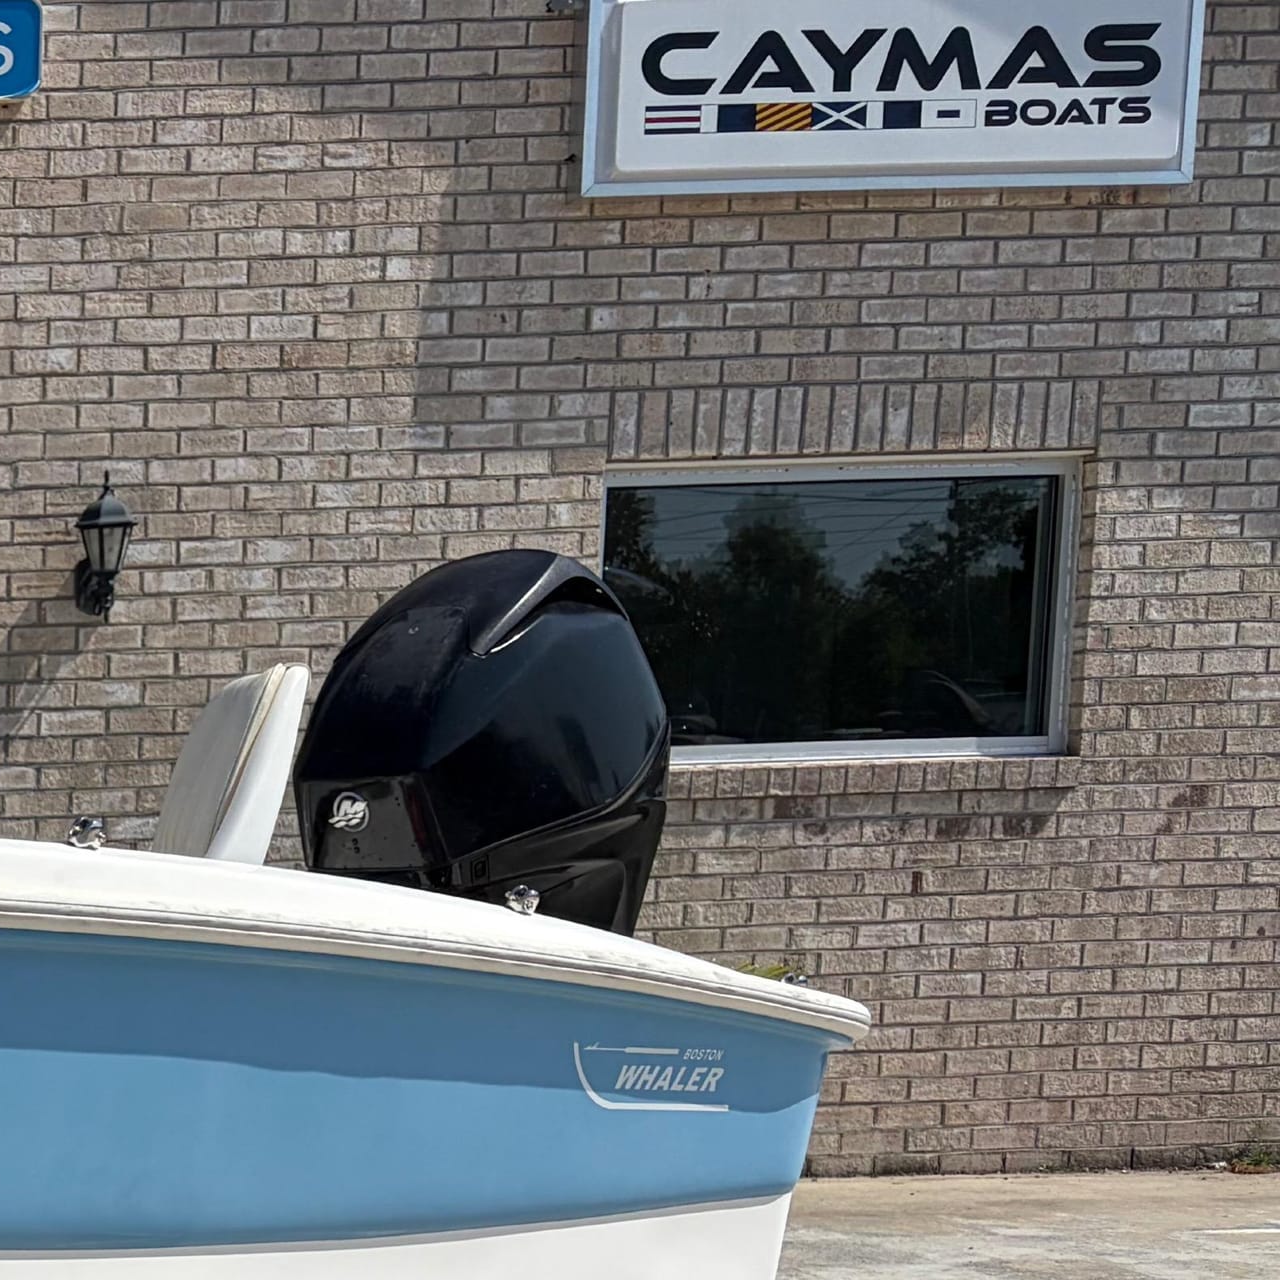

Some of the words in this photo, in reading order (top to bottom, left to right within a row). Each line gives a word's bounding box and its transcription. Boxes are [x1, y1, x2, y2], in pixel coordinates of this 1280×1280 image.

[640, 22, 1163, 96] CAYMAS
[983, 95, 1153, 128] BOATS
[683, 1048, 724, 1061] BOSTON
[614, 1064, 725, 1093] WHALER
